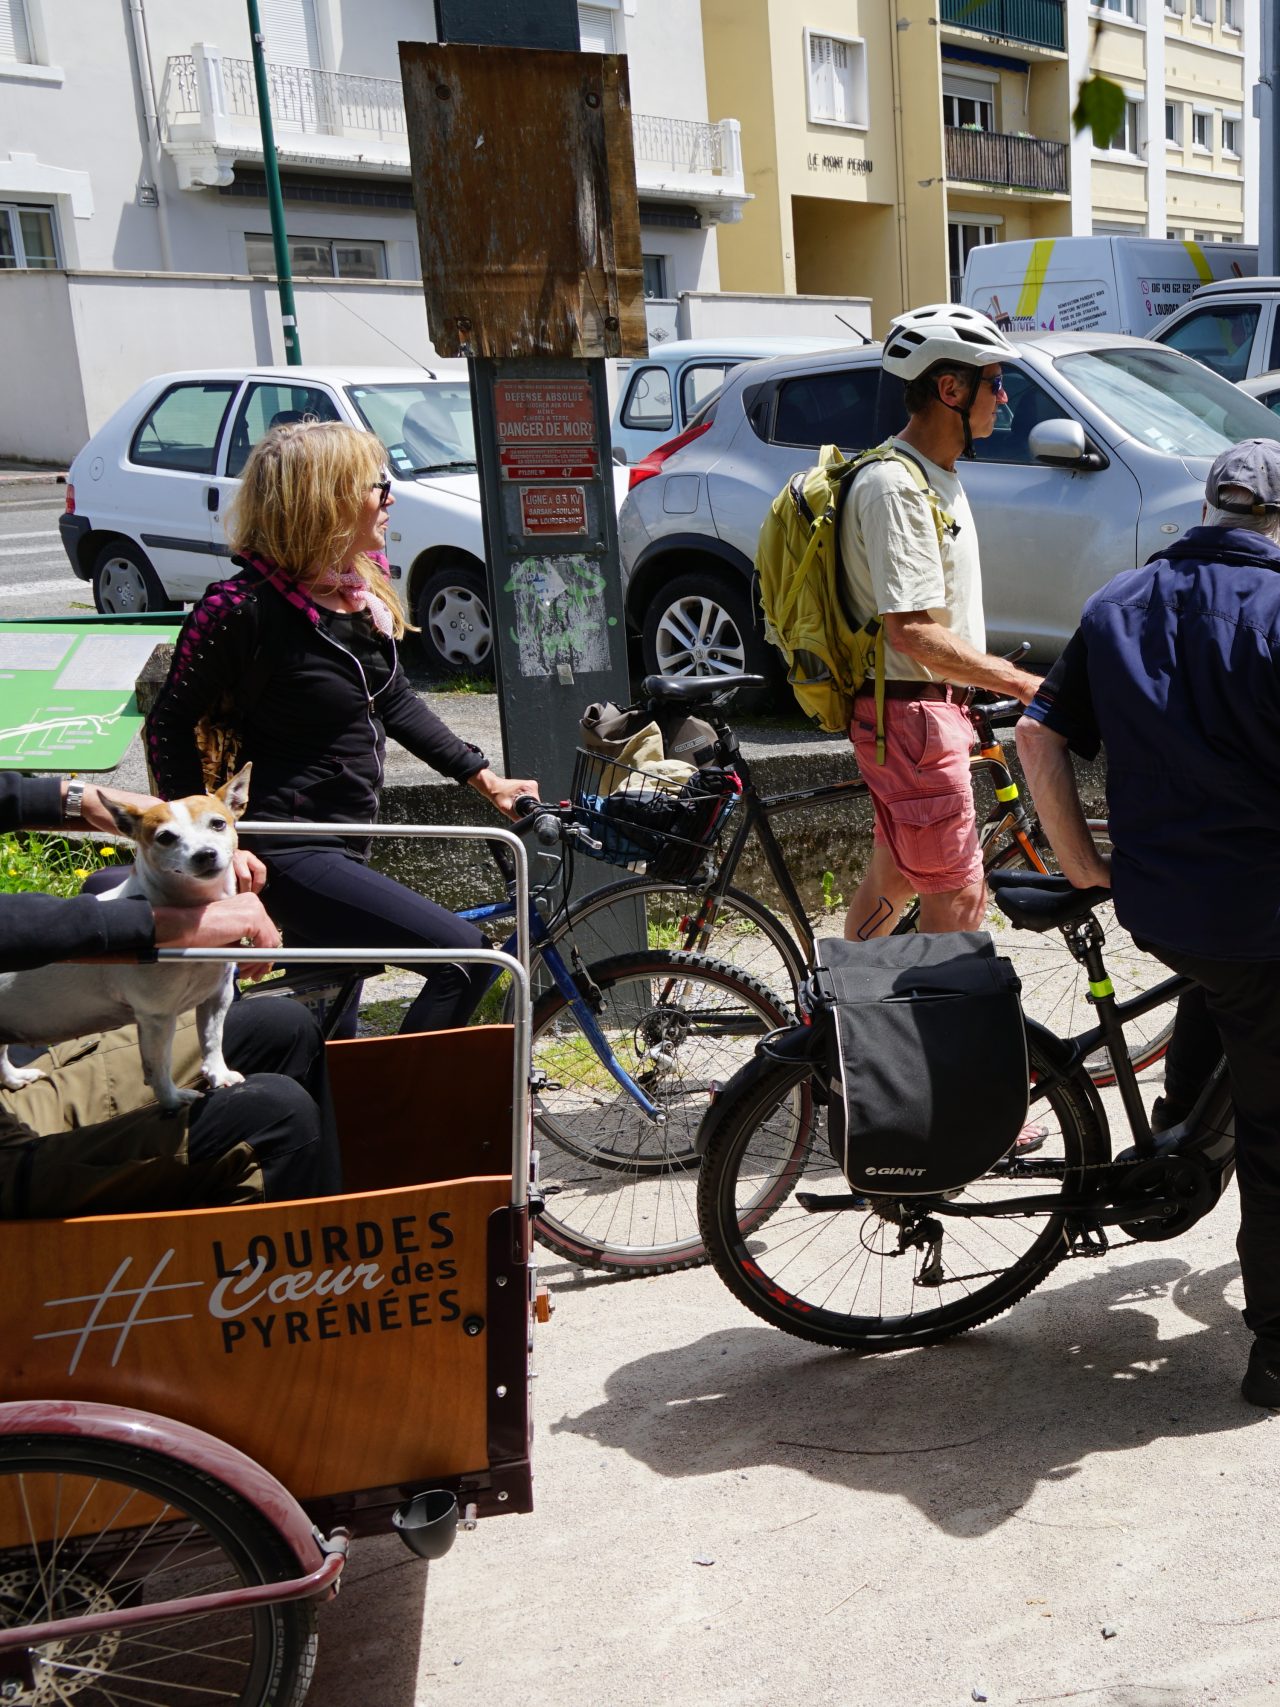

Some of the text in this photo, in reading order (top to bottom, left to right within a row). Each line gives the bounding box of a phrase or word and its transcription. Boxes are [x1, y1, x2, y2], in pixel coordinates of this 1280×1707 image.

[808, 152, 819, 167] LE
[822, 155, 843, 169] MONT
[1162, 283, 1171, 293] 49
[1172, 283, 1181, 293] 62
[1182, 283, 1191, 293] 62
[546, 392, 583, 402] ABSOLUE
[500, 422, 544, 436] DANGER
[546, 422, 561, 436] DE
[562, 468, 573, 478] 47
[526, 495, 548, 505] LIGNE
[877, 1168, 926, 1176] GIANT
[212, 1212, 455, 1278] LOURDES
[208, 1254, 458, 1319] Cœur des
[221, 1288, 462, 1354] PYRÉNÉES
[269, 1618, 284, 1696] SCHWALBE
